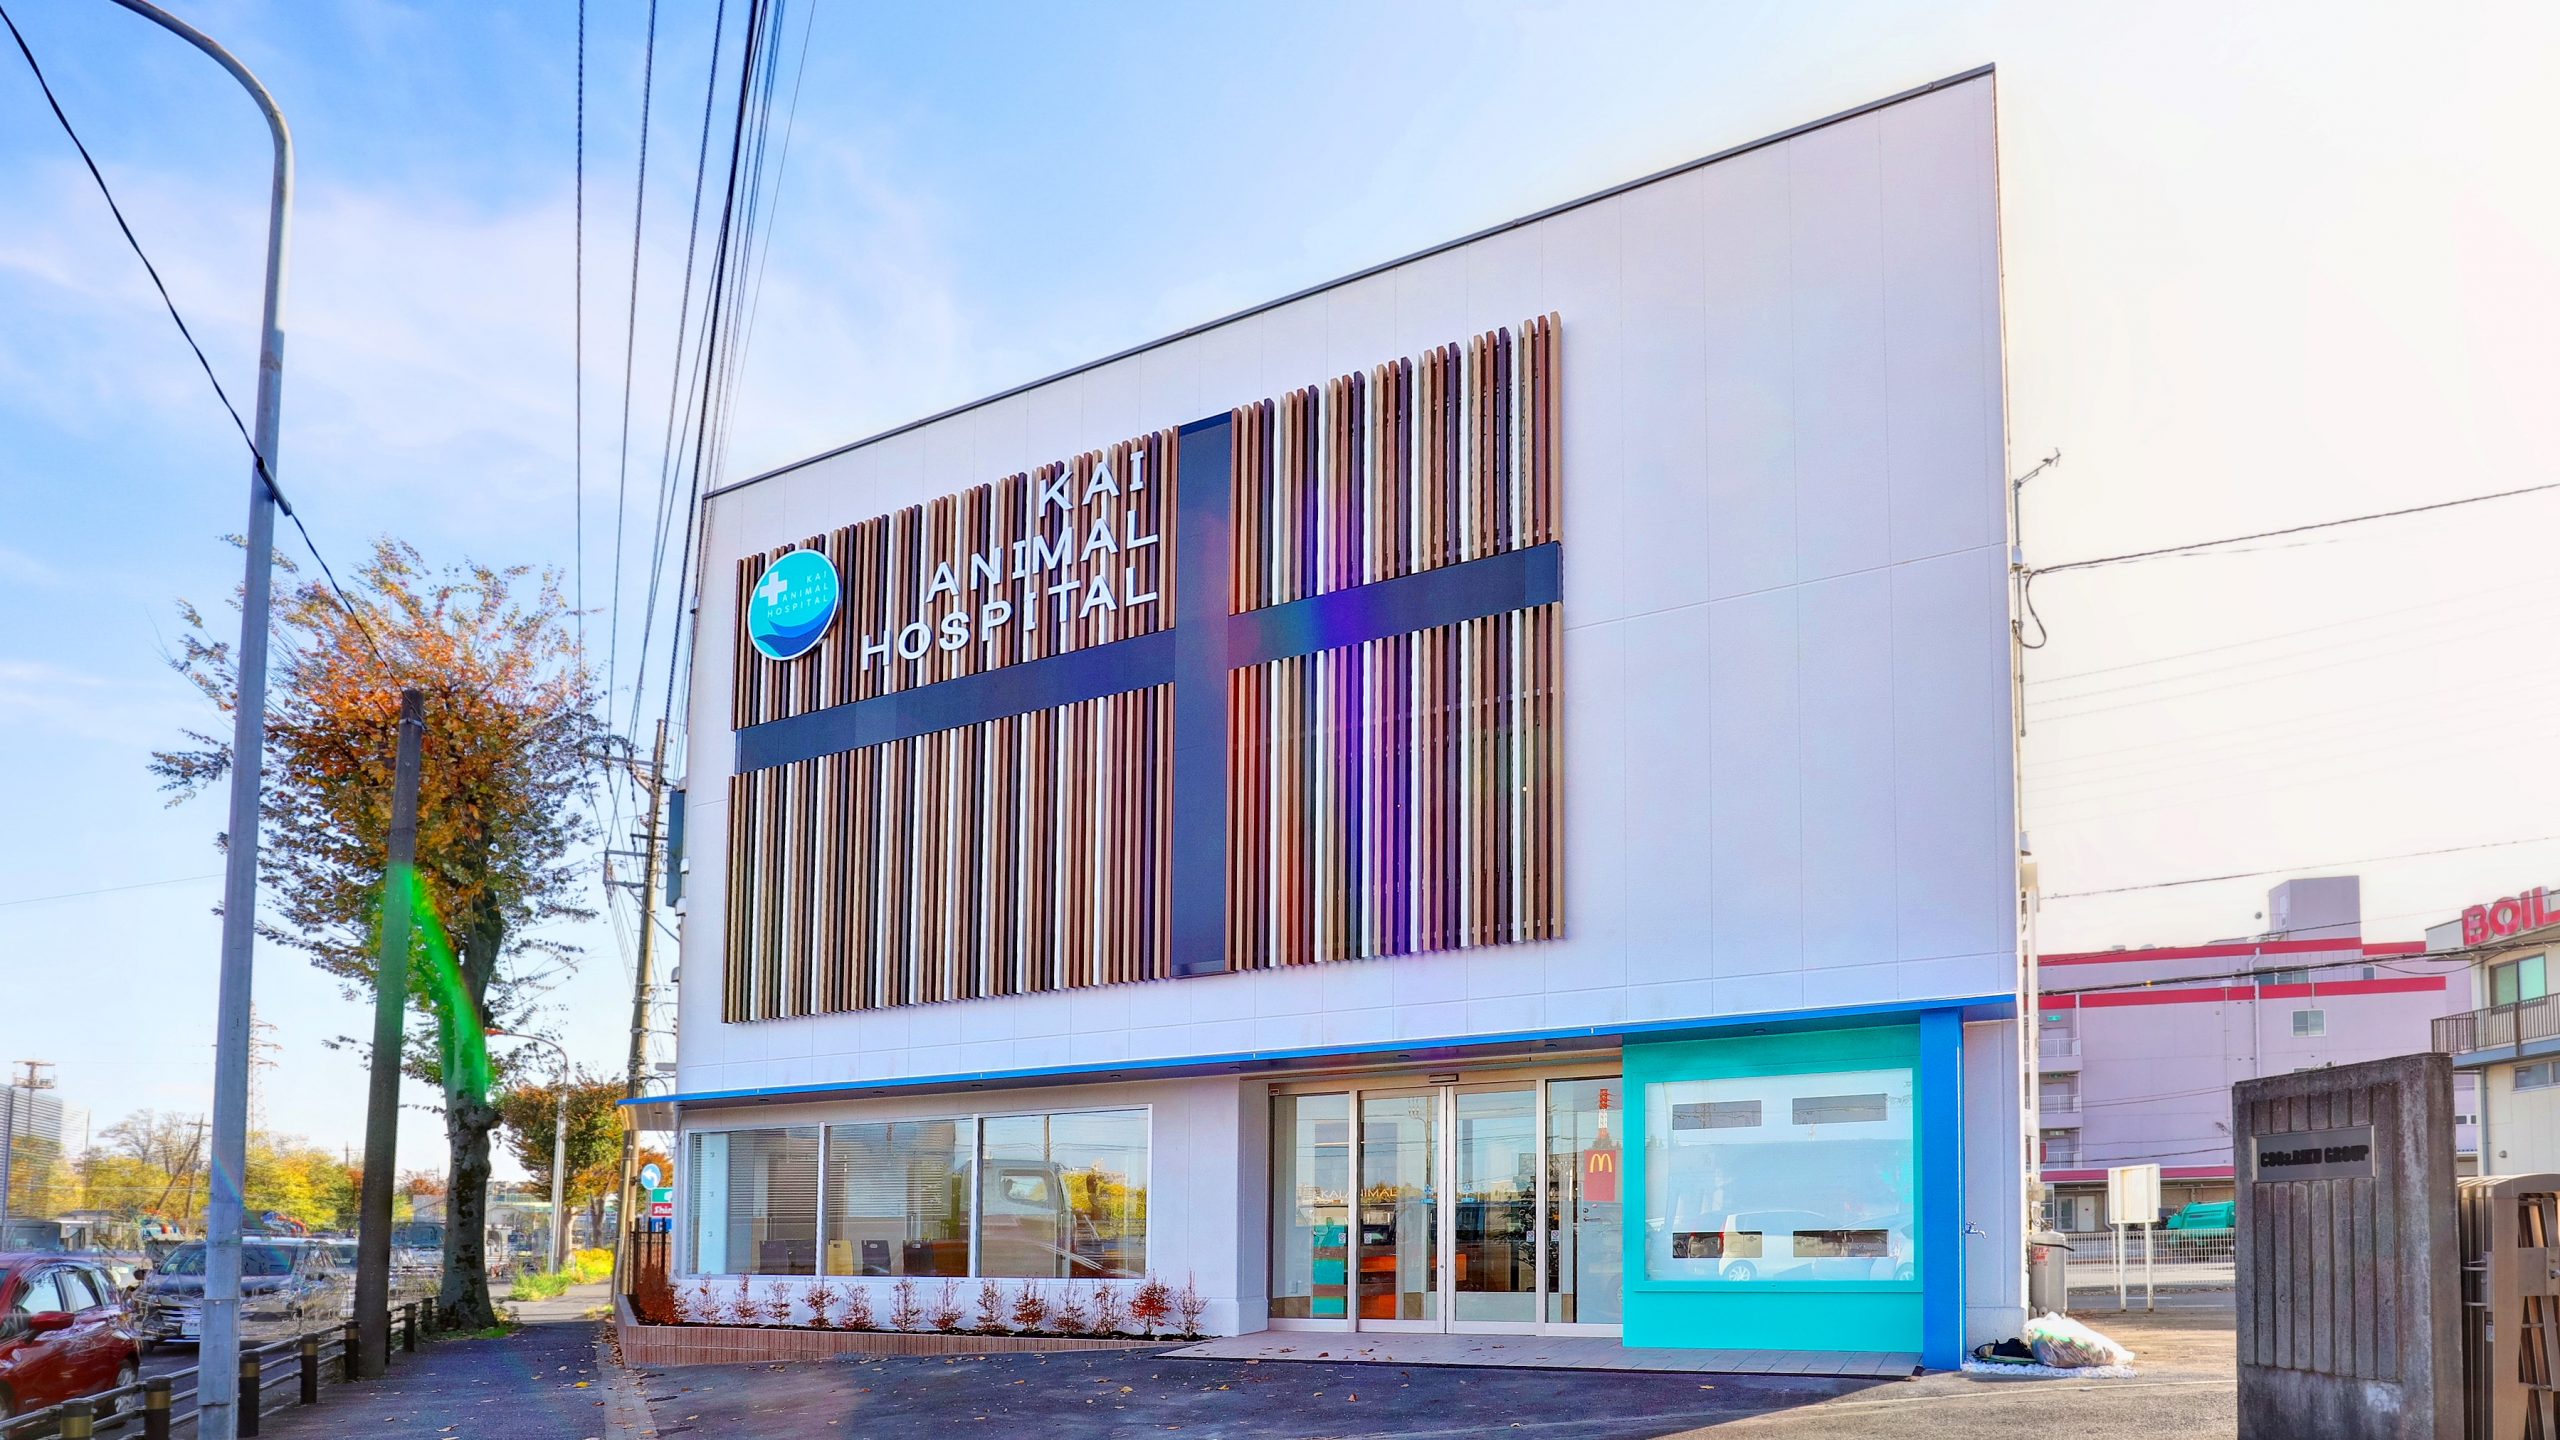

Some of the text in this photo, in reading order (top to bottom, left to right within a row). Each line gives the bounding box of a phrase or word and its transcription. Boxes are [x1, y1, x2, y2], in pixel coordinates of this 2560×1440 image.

[1039, 450, 1145, 518] KAI
[806, 570, 827, 583] KAI
[926, 509, 1159, 603] ANIMAL
[767, 595, 828, 618] HOSPITAL
[782, 582, 829, 602] ANIMAL
[862, 566, 1158, 671] HOSPITAL
